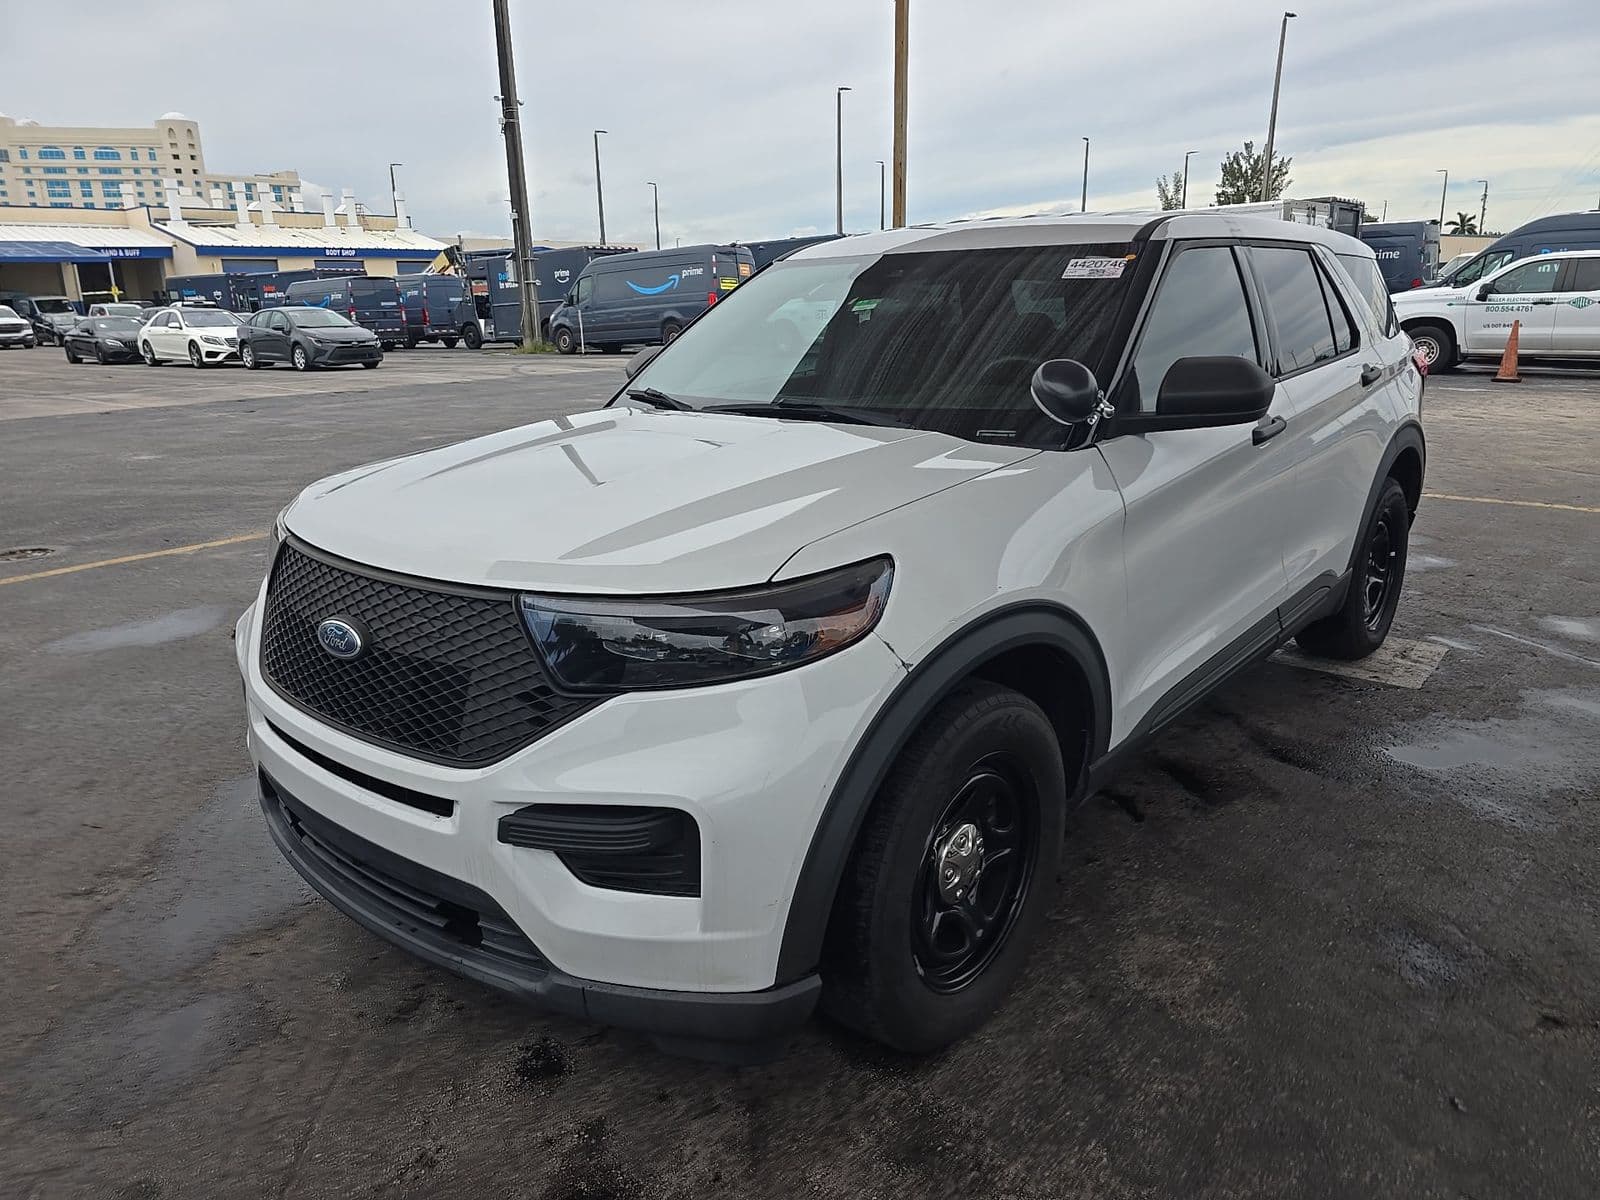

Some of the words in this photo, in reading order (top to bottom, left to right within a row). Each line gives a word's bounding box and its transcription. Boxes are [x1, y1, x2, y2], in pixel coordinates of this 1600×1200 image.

[124, 248, 140, 257] BUFF
[1375, 249, 1400, 259] rime
[1069, 260, 1127, 268] 4420746
[554, 269, 570, 279] prime
[681, 266, 704, 279] prime
[330, 292, 343, 301] prime
[1485, 305, 1534, 313] 800.554.4761
[325, 626, 349, 650] Ford
